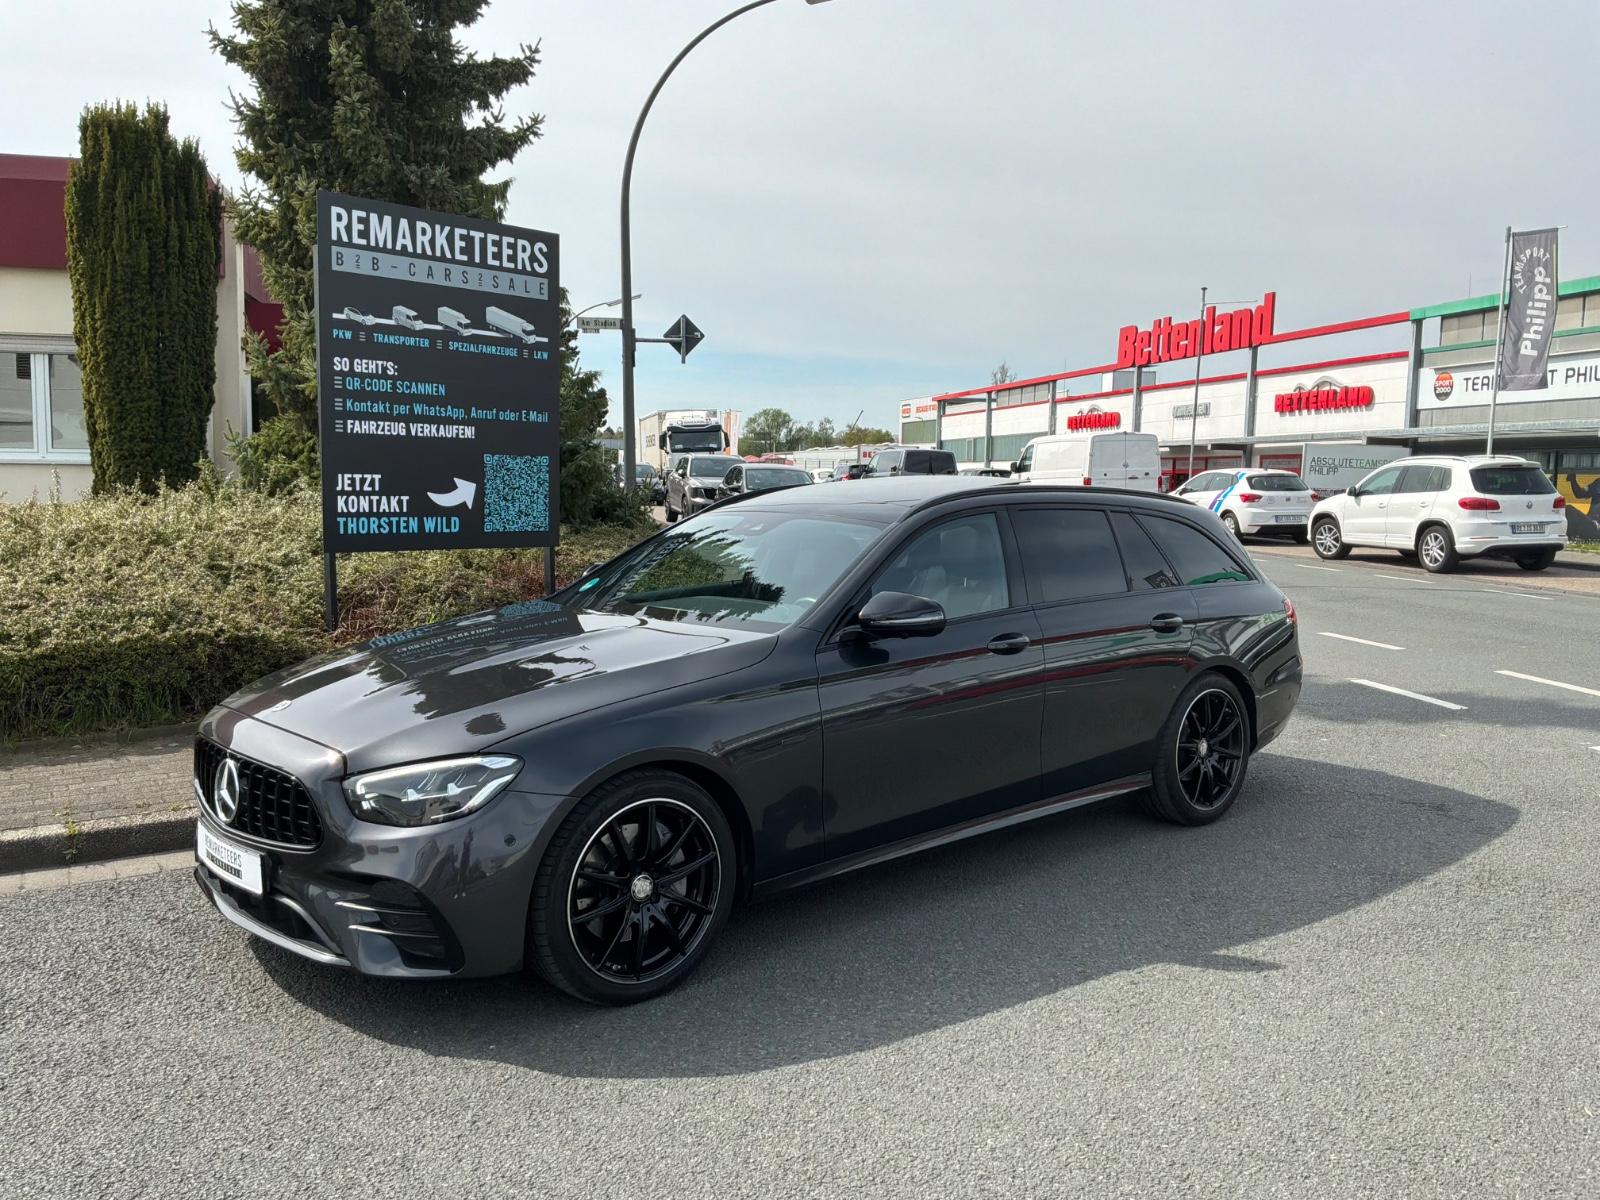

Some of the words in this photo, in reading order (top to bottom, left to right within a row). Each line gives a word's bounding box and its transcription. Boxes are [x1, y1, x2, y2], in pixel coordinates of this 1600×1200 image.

[330, 205, 549, 274] REMARKETEERS
[1513, 246, 1550, 295] TEAMSPORT
[1519, 266, 1552, 357] Philipp
[1117, 291, 1276, 370] Bettenland
[332, 329, 353, 341] PKW
[373, 333, 430, 348] TRANSPORTER
[448, 341, 518, 357] SPEZIALFAHRZEUGE
[533, 351, 549, 361] LKW
[333, 357, 350, 372] SO
[353, 357, 398, 376] GEHT'S:
[345, 377, 394, 394] QR-CODE
[396, 381, 446, 396] SCANNEN
[1434, 379, 1454, 388] SPORT
[1274, 385, 1375, 413] BETTENLAND
[346, 398, 391, 414] Kontakt
[393, 403, 411, 417] per
[413, 403, 468, 421] WhatsApp,
[470, 407, 497, 420] Anruf
[499, 408, 520, 421] oder
[522, 411, 549, 423] E-Mail
[347, 419, 406, 436] FAHRZEUG
[409, 423, 476, 439] VERKAUFEN!
[1067, 411, 1121, 430] BETTENLAND
[1309, 466, 1339, 476] PHILIPP
[336, 473, 382, 492] JETZT
[337, 495, 410, 513] KONTAKT
[336, 516, 419, 535] THORSTEN
[423, 516, 460, 534] WILD
